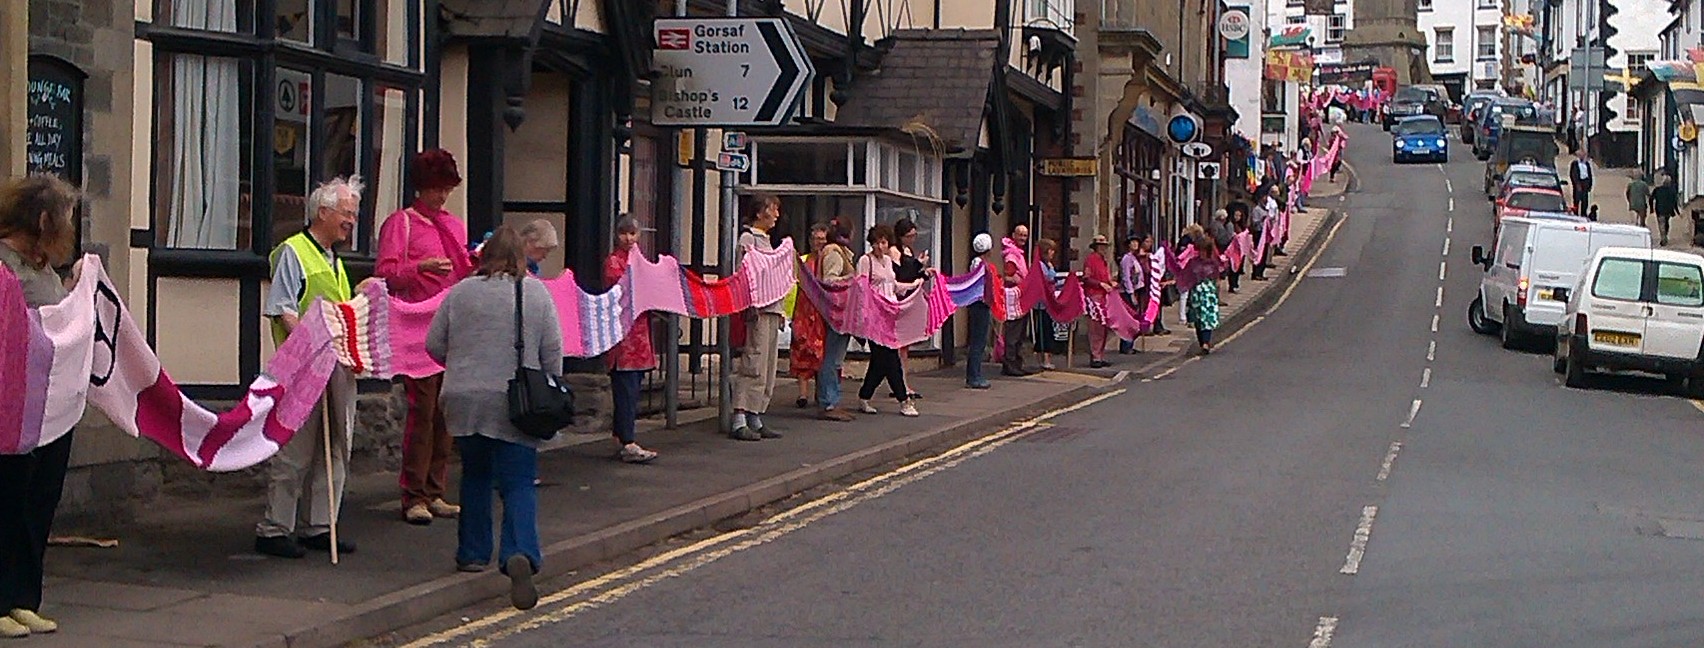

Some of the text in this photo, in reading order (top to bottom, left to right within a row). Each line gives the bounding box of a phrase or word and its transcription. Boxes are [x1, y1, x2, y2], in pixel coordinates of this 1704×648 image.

[695, 25, 745, 37] Gorsaf
[1221, 23, 1246, 33] HSBC
[695, 41, 750, 54] Station
[661, 64, 750, 78] Clun 7
[659, 88, 719, 104] Bishop's
[733, 97, 748, 110] 12
[665, 106, 712, 119] Castle
